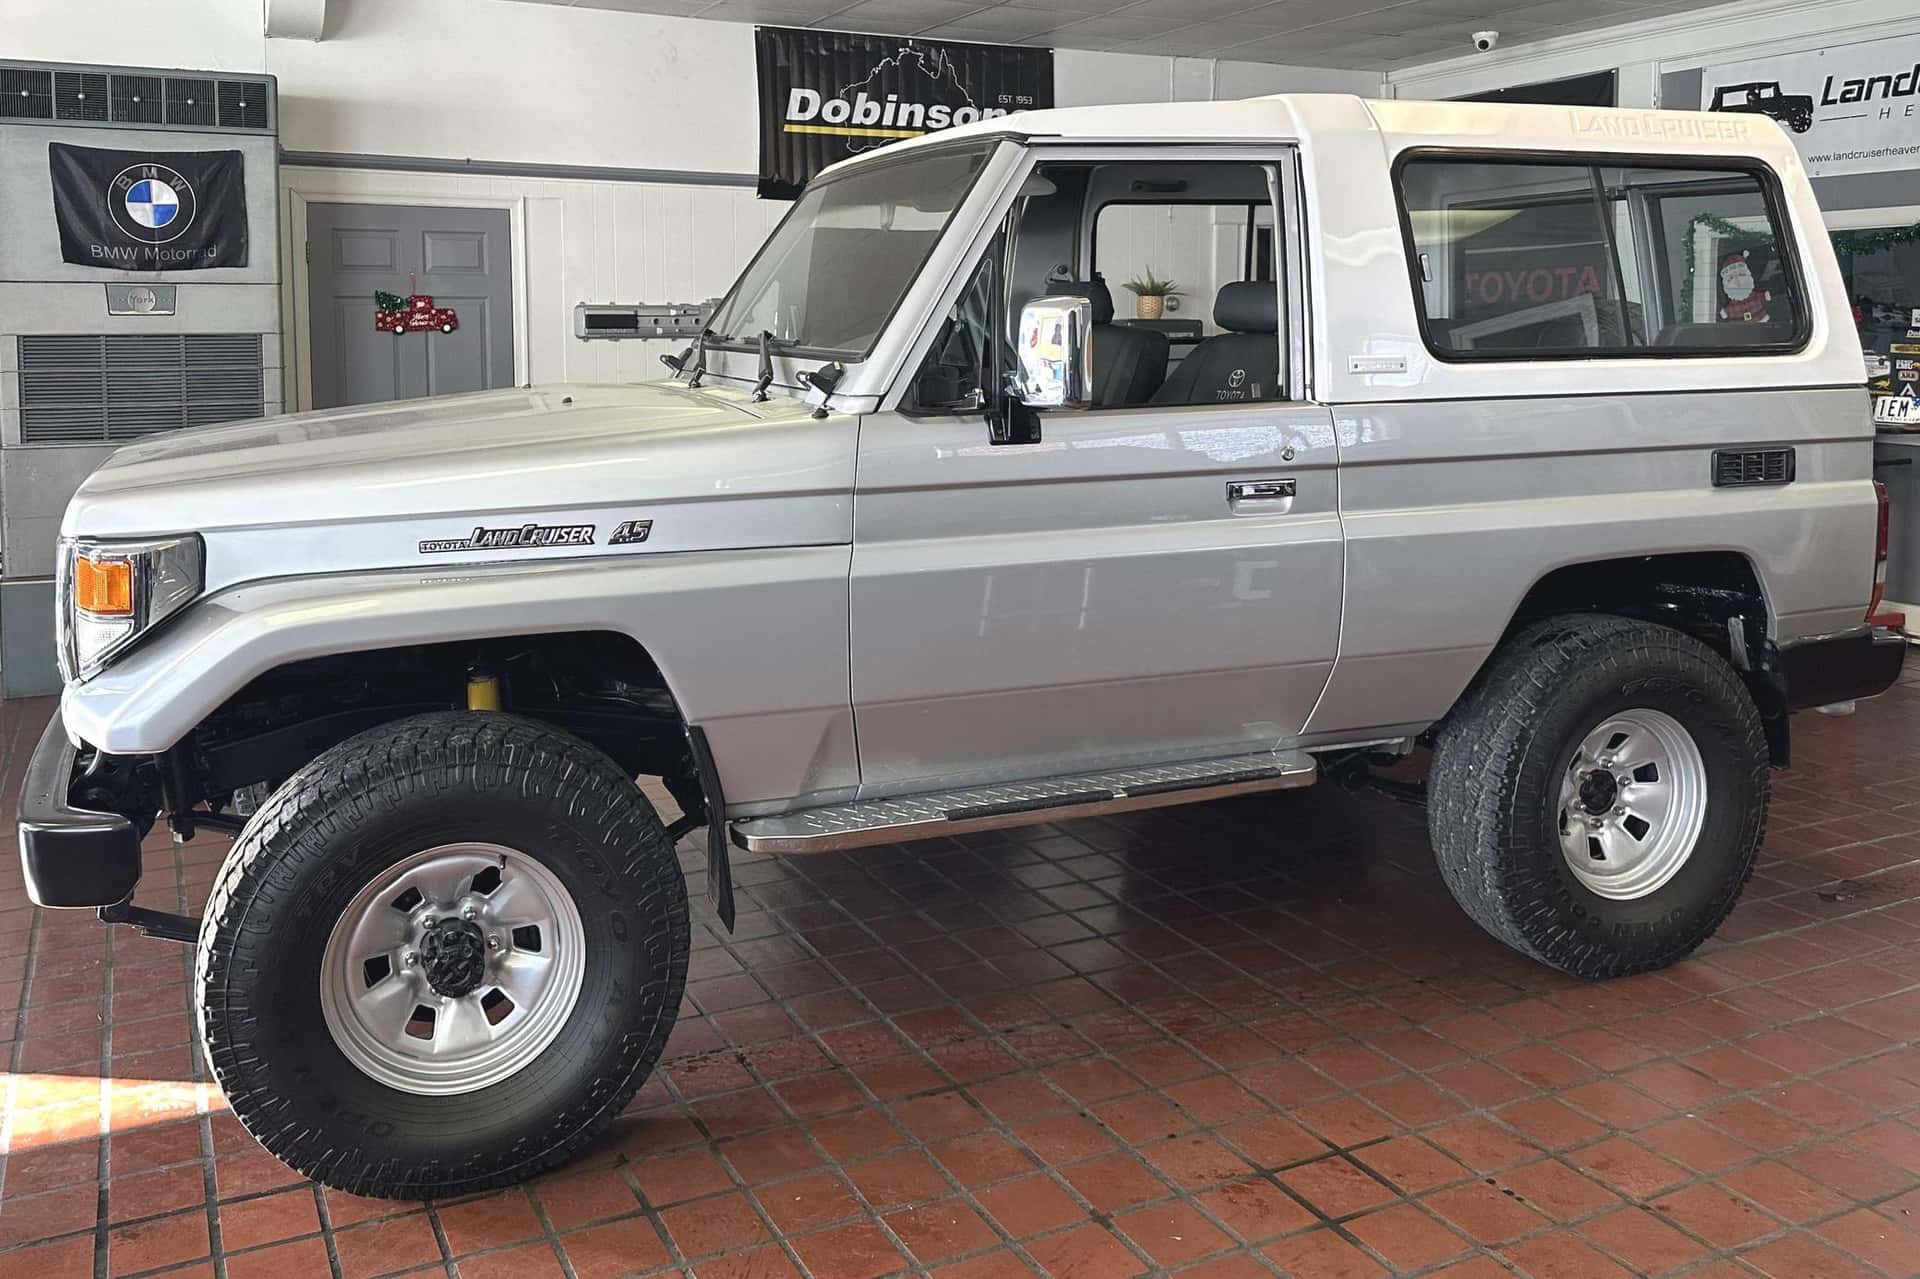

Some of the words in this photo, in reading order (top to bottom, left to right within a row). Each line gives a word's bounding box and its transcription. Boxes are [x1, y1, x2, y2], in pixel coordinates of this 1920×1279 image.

[785, 87, 1028, 129] Dobinso
[998, 94, 1012, 104] EST
[1015, 95, 1033, 105] 1953
[115, 166, 188, 193] BMW
[90, 244, 138, 260] BMW
[144, 244, 218, 261] Motorrd
[421, 541, 466, 551] TOYOTA
